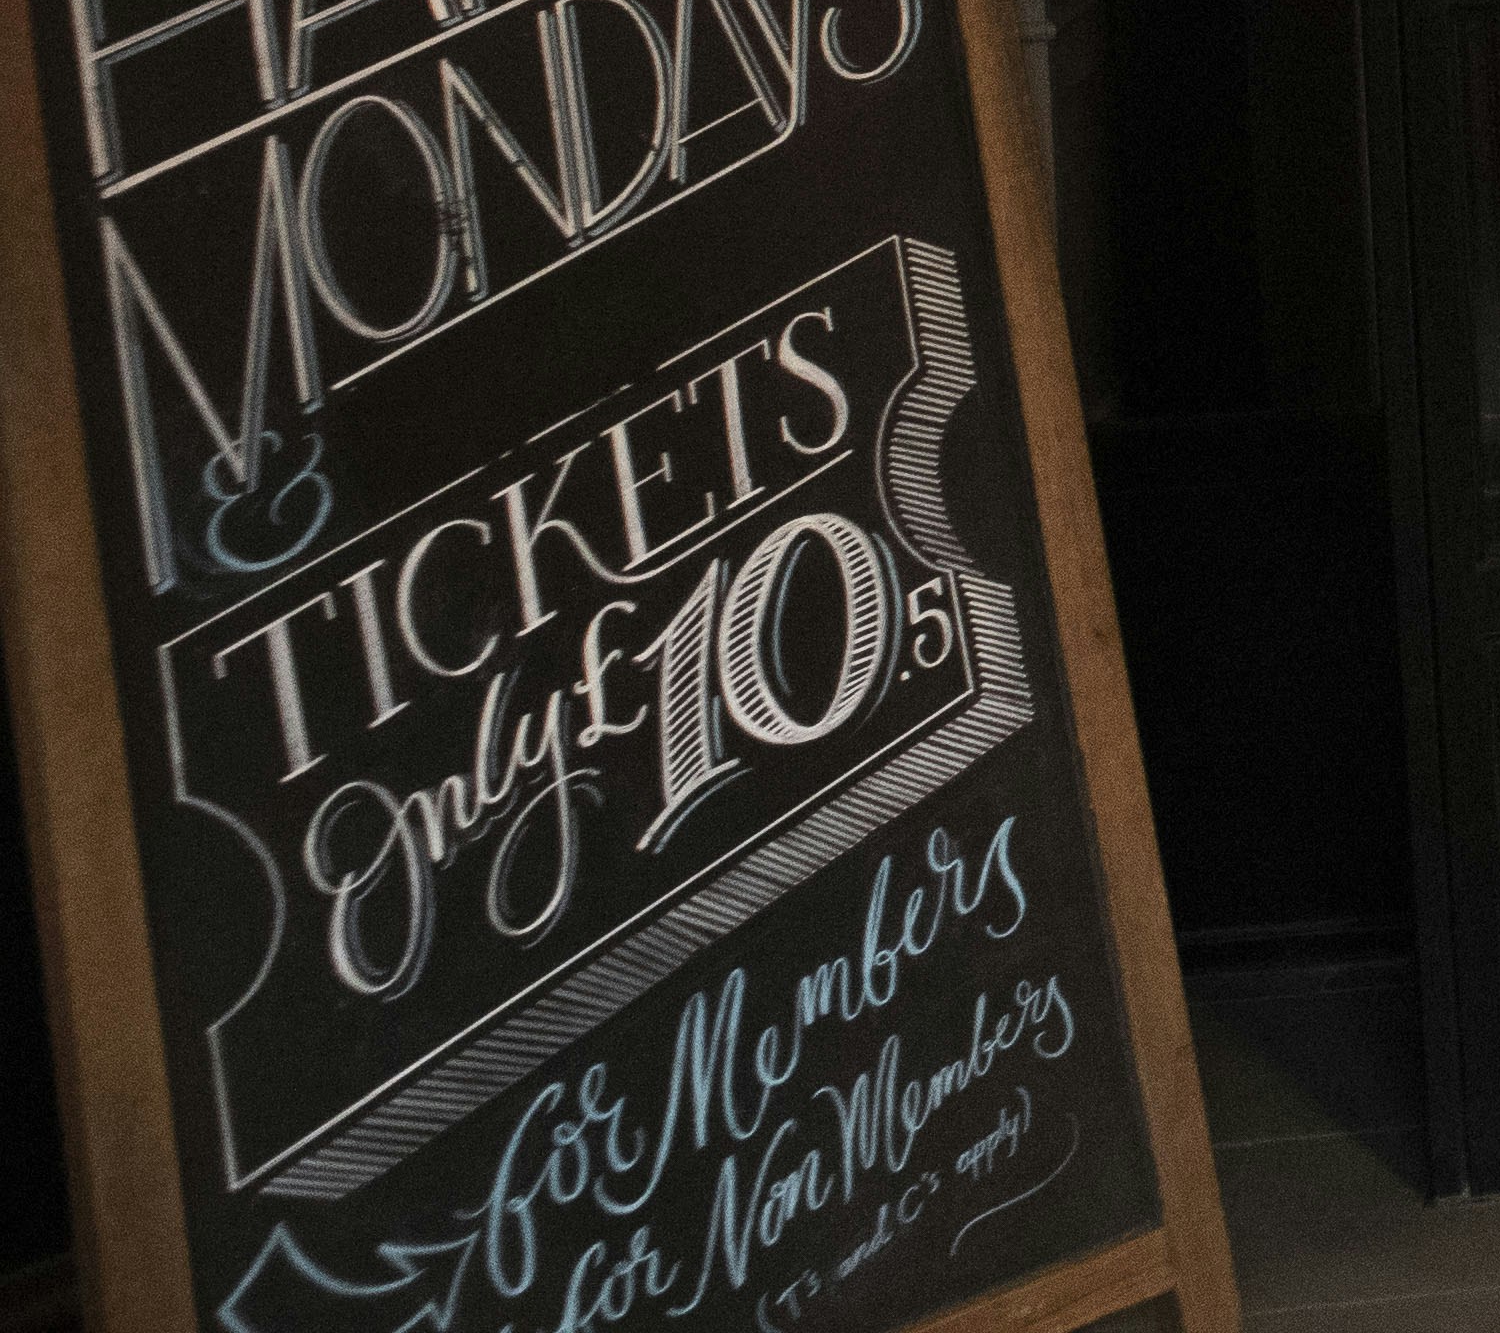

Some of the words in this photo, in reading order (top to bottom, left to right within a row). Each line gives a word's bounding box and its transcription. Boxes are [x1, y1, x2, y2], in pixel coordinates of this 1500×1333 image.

[202, 430, 335, 573] &
[212, 306, 850, 784] TICKETS
[303, 671, 600, 998] Only
[482, 1061, 645, 1296] for
[598, 817, 1027, 1213] Members
[669, 1117, 836, 1318] Non
[811, 974, 1075, 1205] Members
[955, 1085, 1032, 1181] apply)
